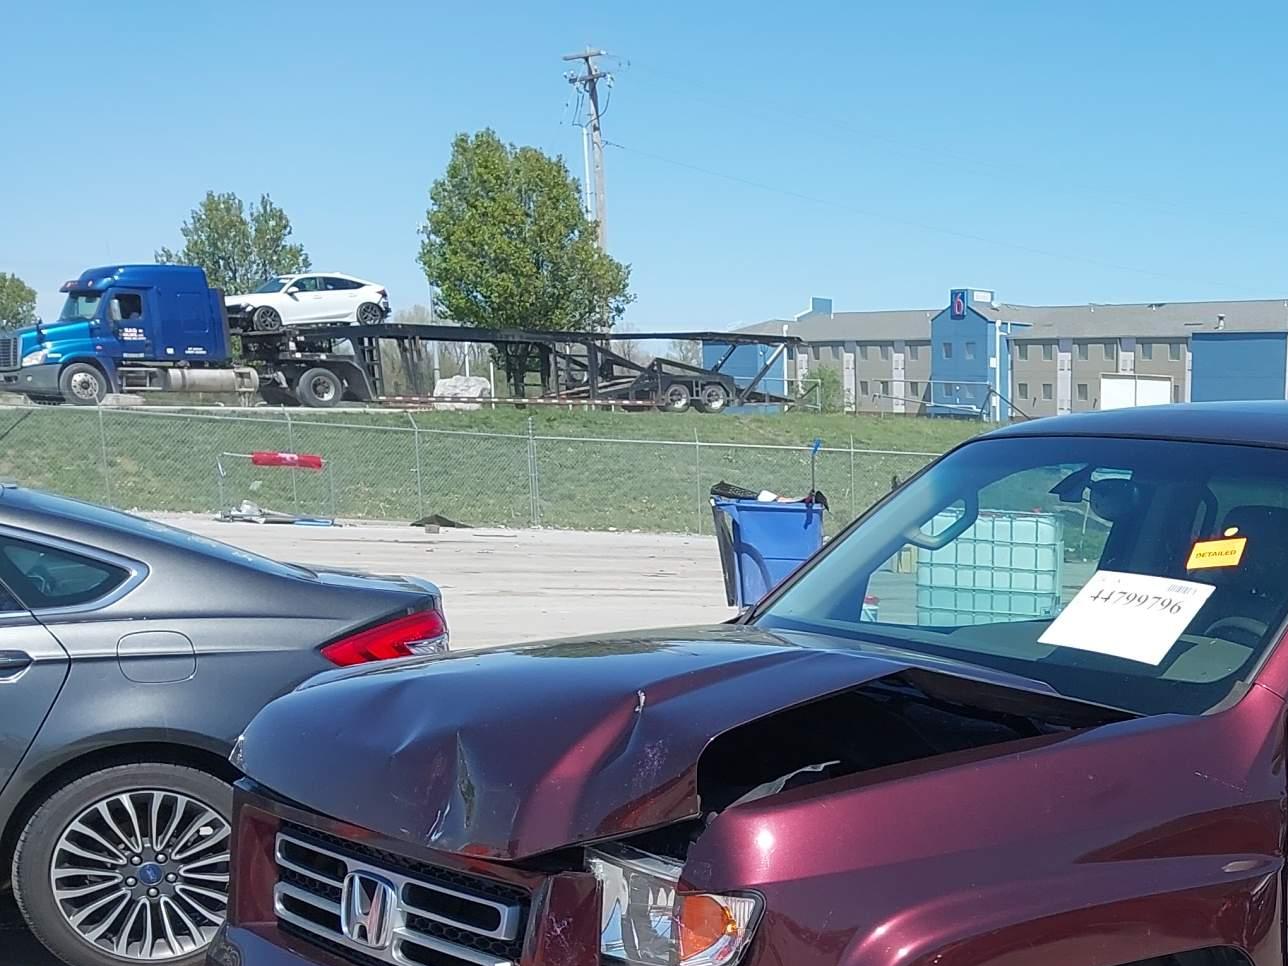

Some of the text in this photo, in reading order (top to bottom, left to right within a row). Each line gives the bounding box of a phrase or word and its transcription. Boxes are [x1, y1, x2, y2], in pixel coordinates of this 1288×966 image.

[954, 292, 964, 315] 6
[1195, 549, 1237, 559] DETAILED
[1090, 588, 1184, 615] 44799796
